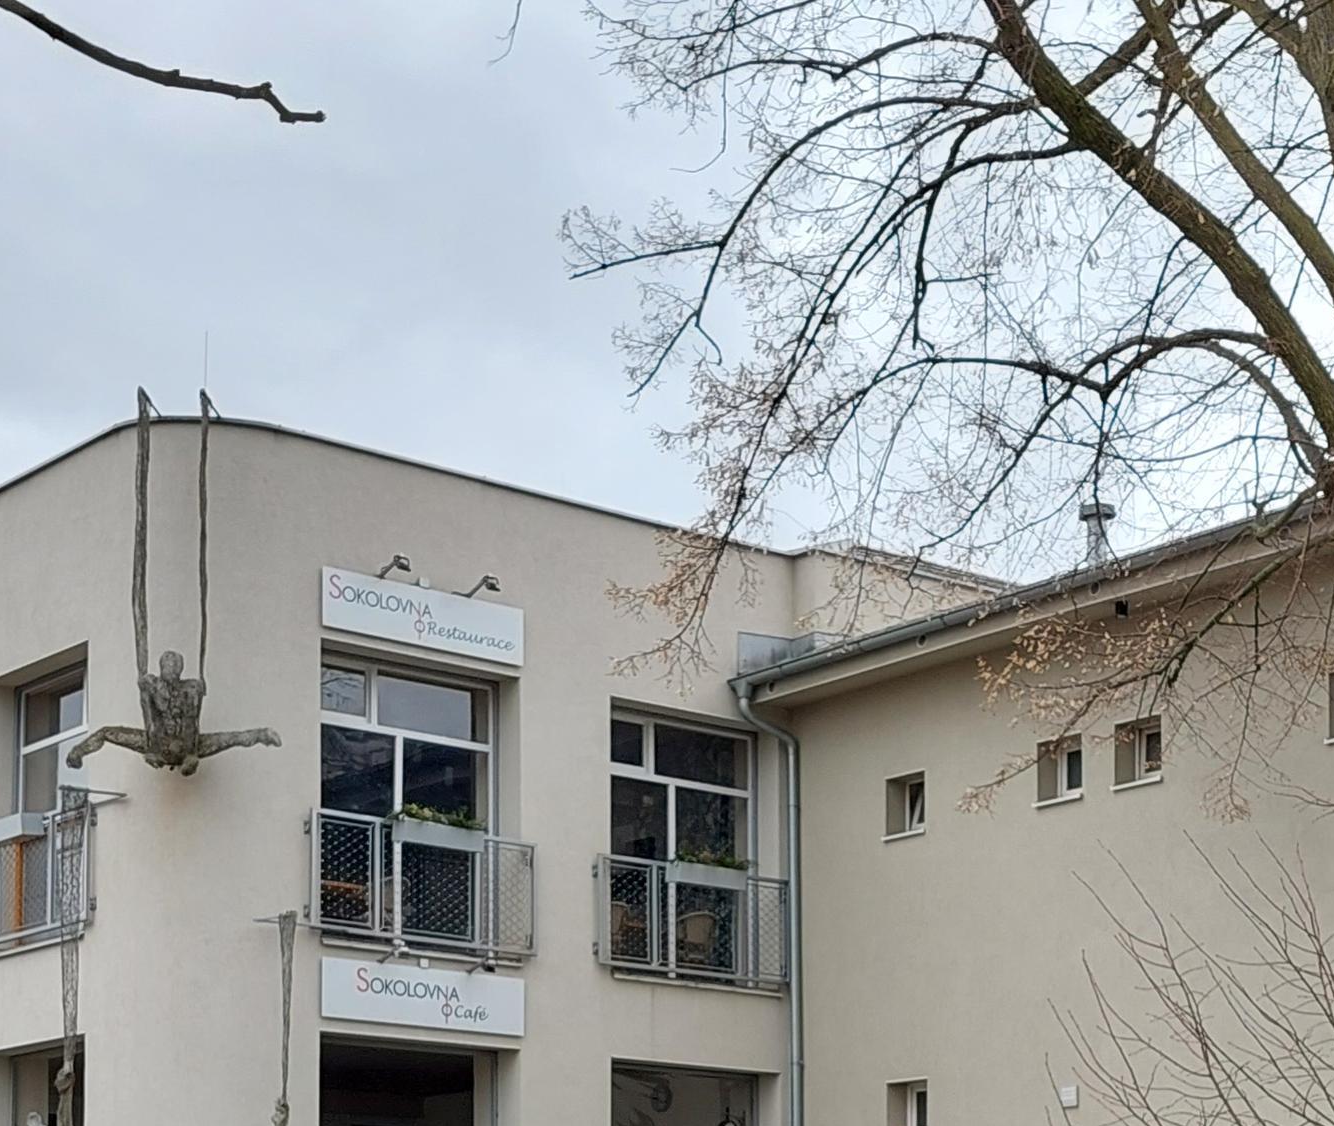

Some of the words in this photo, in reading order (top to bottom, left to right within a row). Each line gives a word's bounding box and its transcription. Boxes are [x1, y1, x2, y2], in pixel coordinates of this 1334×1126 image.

[328, 574, 433, 619] SOKOLOVNA
[427, 620, 515, 651] Restaurace
[357, 967, 460, 1002] SOKOLOVNA
[454, 1004, 489, 1021] Café
